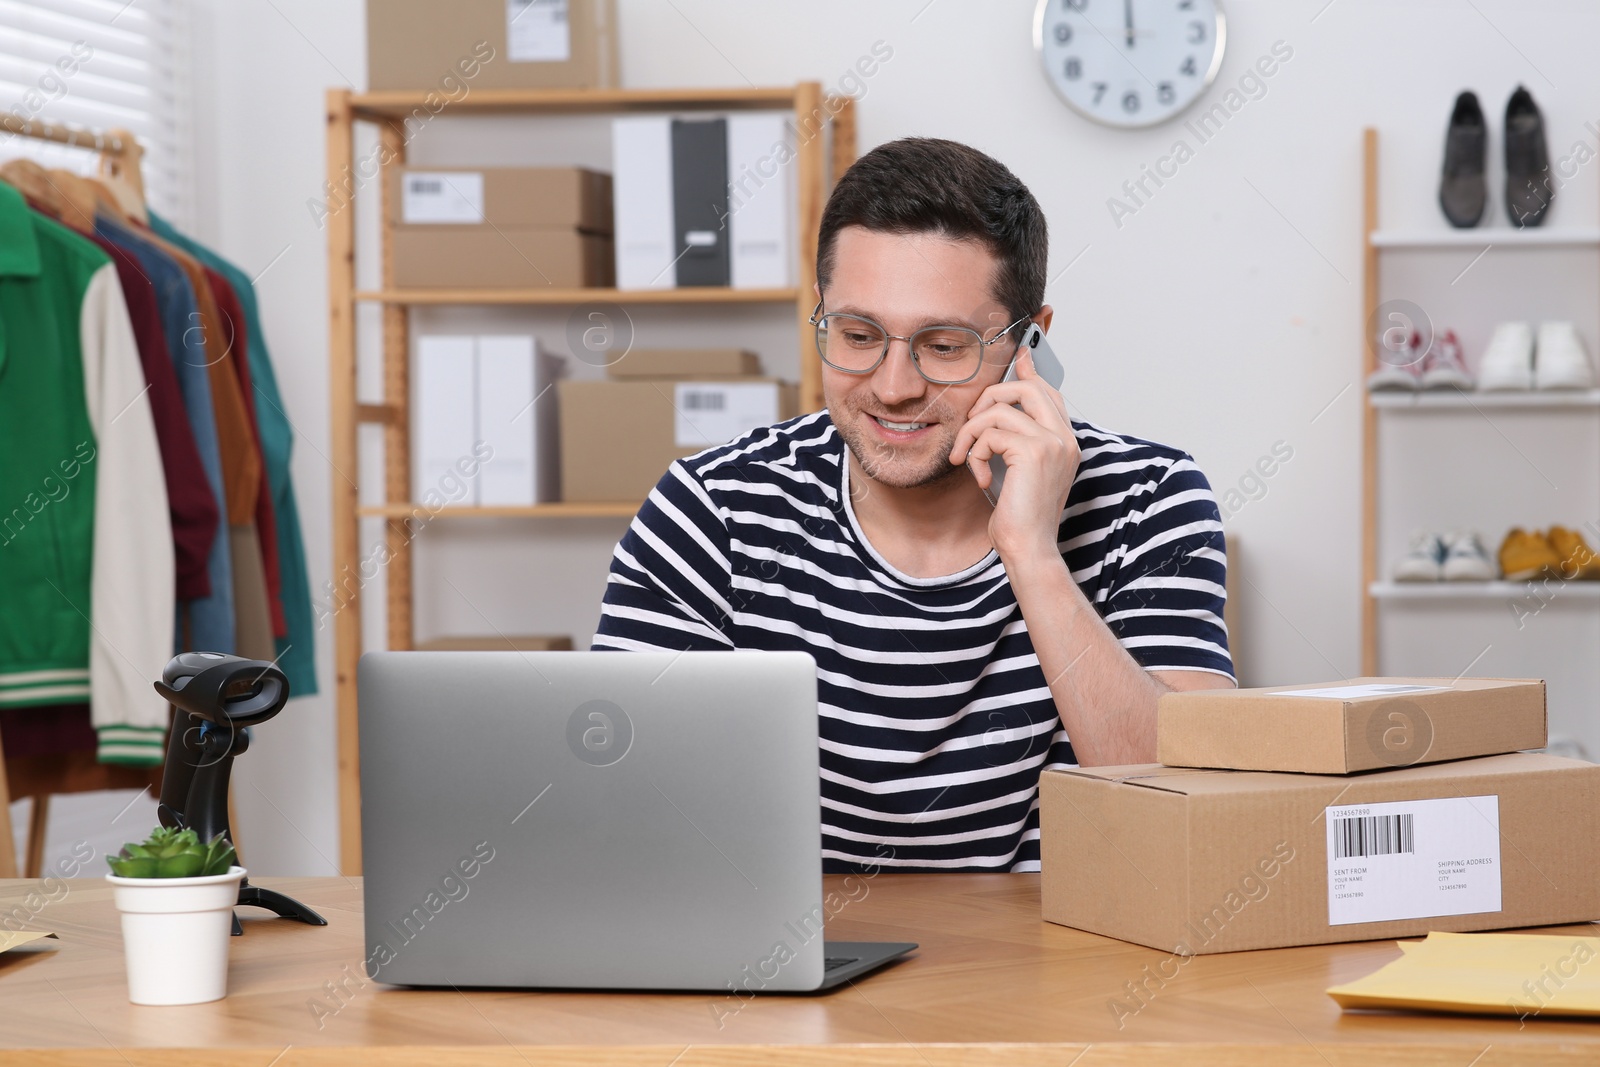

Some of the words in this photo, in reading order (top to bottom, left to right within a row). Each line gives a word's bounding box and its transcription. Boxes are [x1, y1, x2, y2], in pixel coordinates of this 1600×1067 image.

[1053, 22, 1073, 47] 9
[1186, 20, 1206, 45] 3
[1063, 56, 1083, 81] 8
[1179, 55, 1198, 77] 4
[1091, 81, 1109, 106] 7
[1121, 89, 1141, 114] 6
[1156, 80, 1176, 106] 5
[1333, 809, 1370, 817] 1234567890
[1334, 868, 1349, 876] SENT
[1350, 867, 1367, 875] FROM
[1438, 860, 1465, 868] SHIPPING
[1466, 858, 1492, 866] ADDRESS
